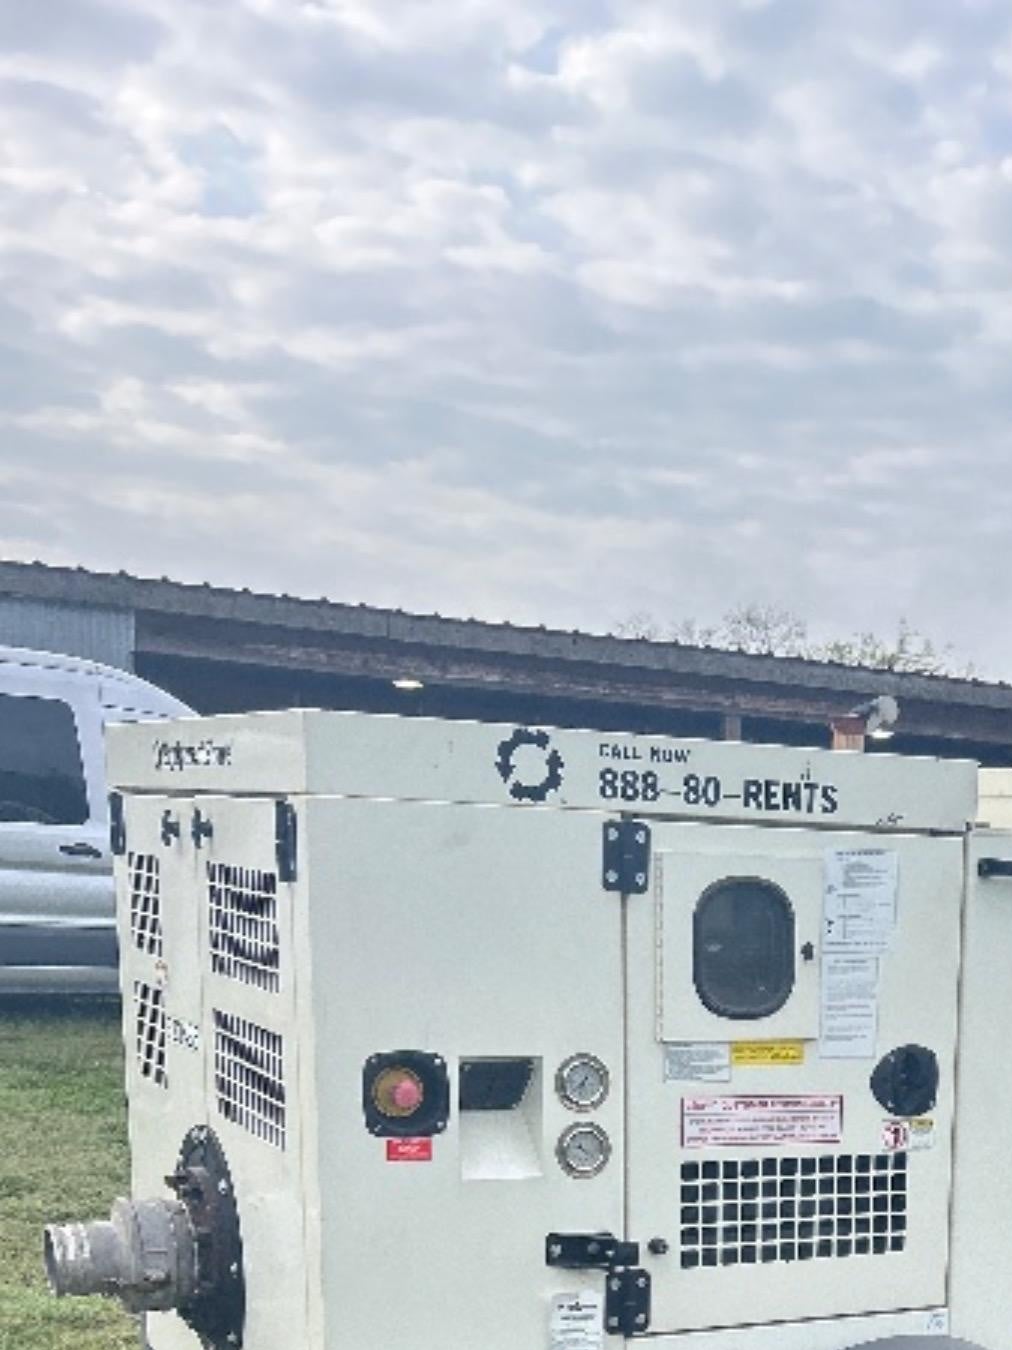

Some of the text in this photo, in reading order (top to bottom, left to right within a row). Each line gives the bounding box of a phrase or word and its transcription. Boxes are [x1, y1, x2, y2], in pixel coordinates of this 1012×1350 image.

[599, 743, 691, 763] CALL NOW
[599, 767, 839, 814] 888-80-RENTS
